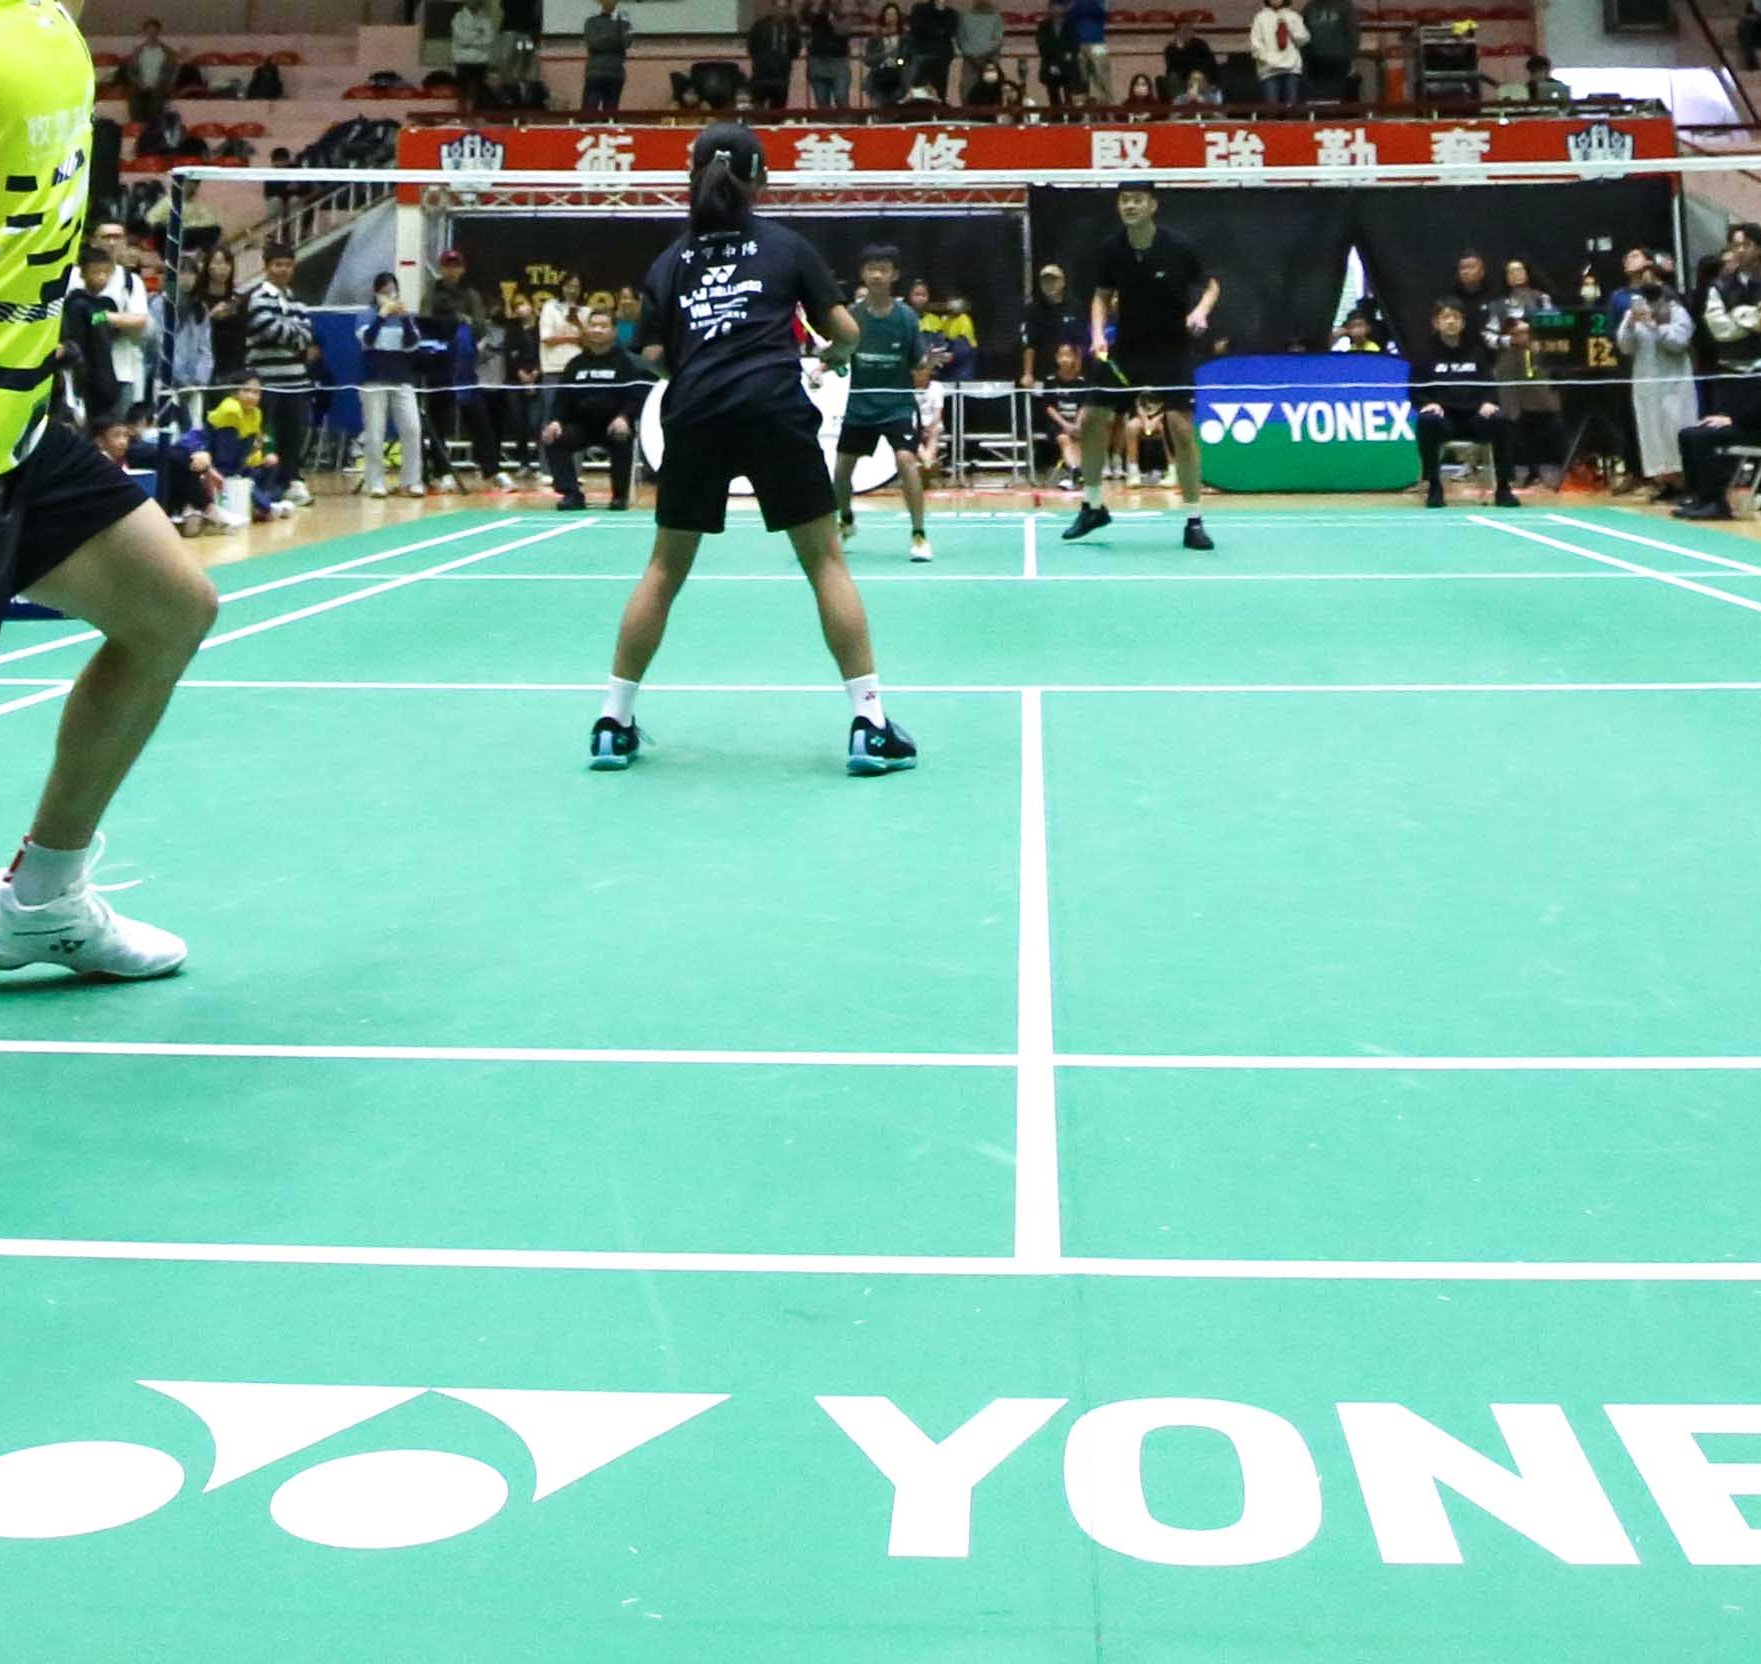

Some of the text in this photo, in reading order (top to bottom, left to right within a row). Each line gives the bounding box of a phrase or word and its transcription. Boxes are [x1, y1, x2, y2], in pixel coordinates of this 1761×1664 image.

[574, 133, 969, 190] 術兼修
[1280, 401, 1416, 442] YONEX
